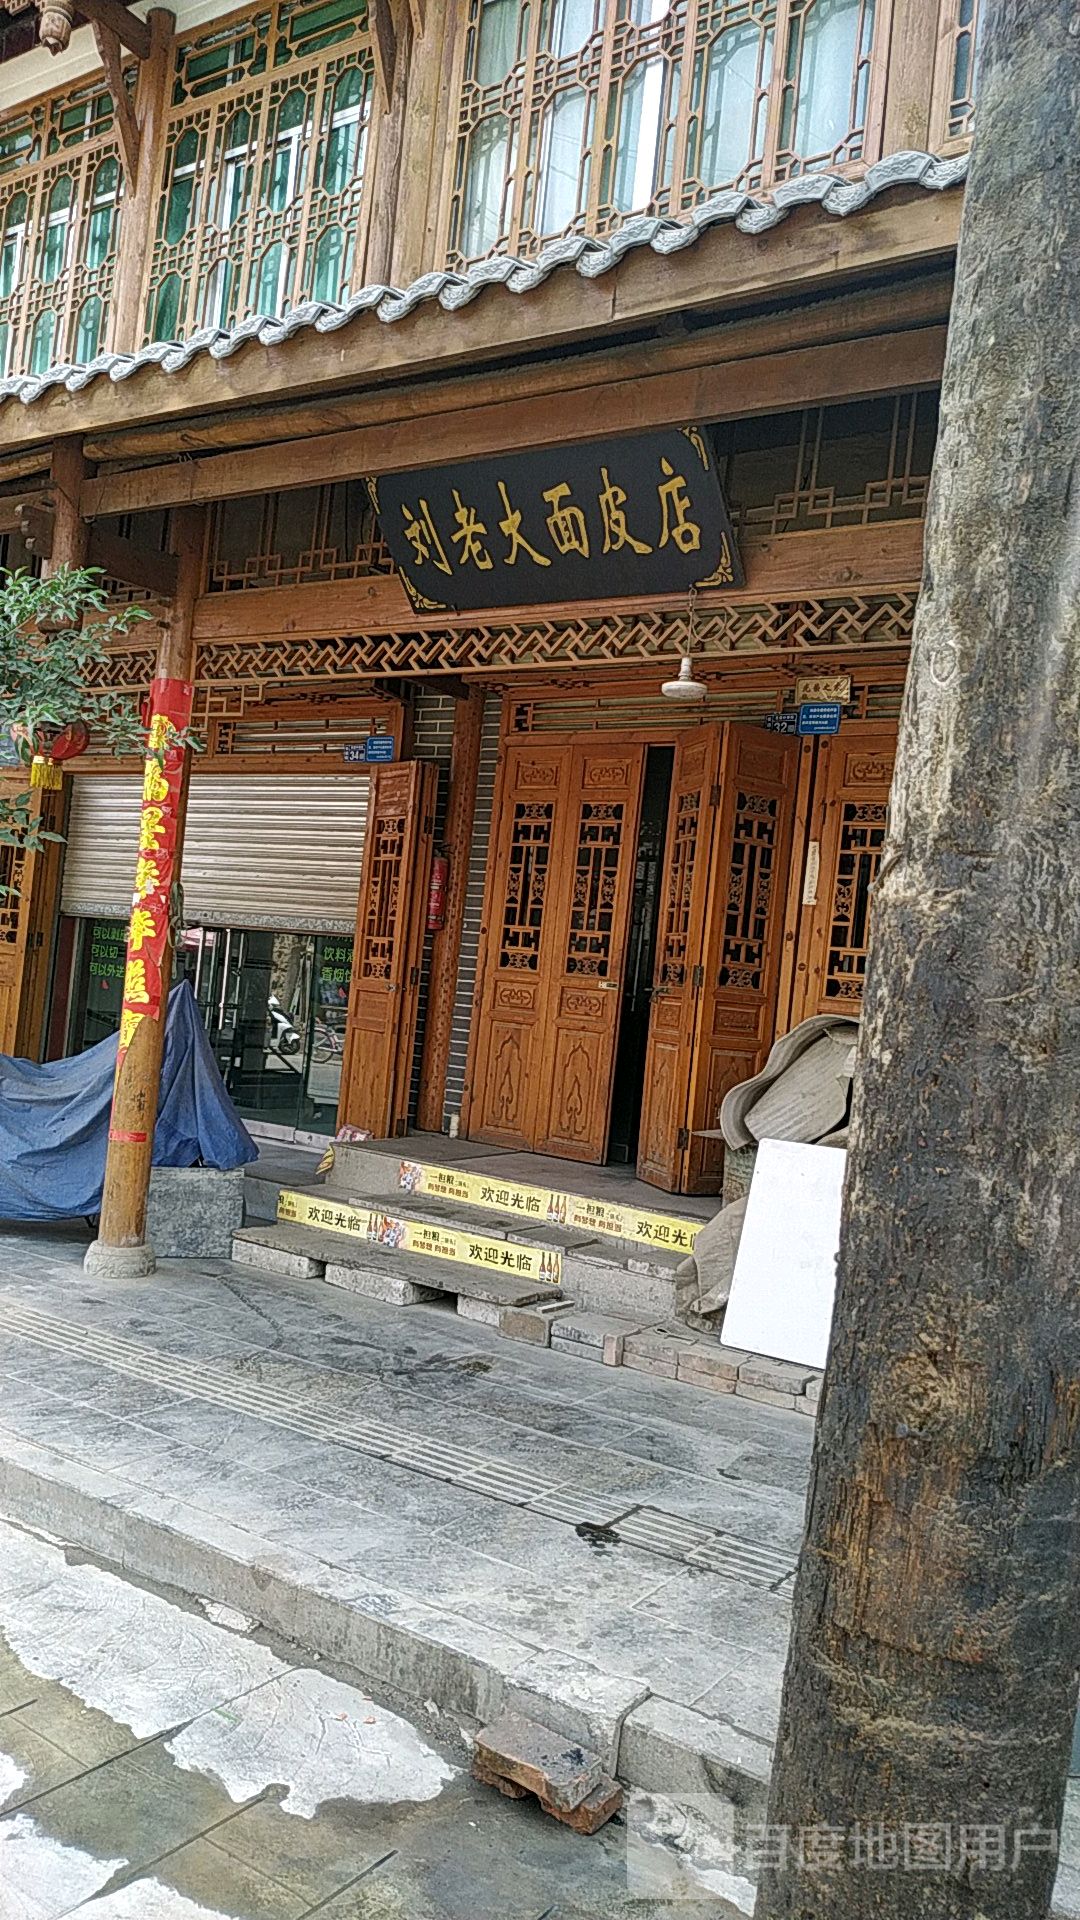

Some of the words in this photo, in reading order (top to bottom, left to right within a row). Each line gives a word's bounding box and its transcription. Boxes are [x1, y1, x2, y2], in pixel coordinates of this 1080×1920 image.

[402, 457, 701, 575] 刘老大面皮店
[480, 1187, 542, 1213] 欢迎光临
[307, 1206, 361, 1232] 欢迎光临
[468, 1244, 533, 1272] 欢迎光临
